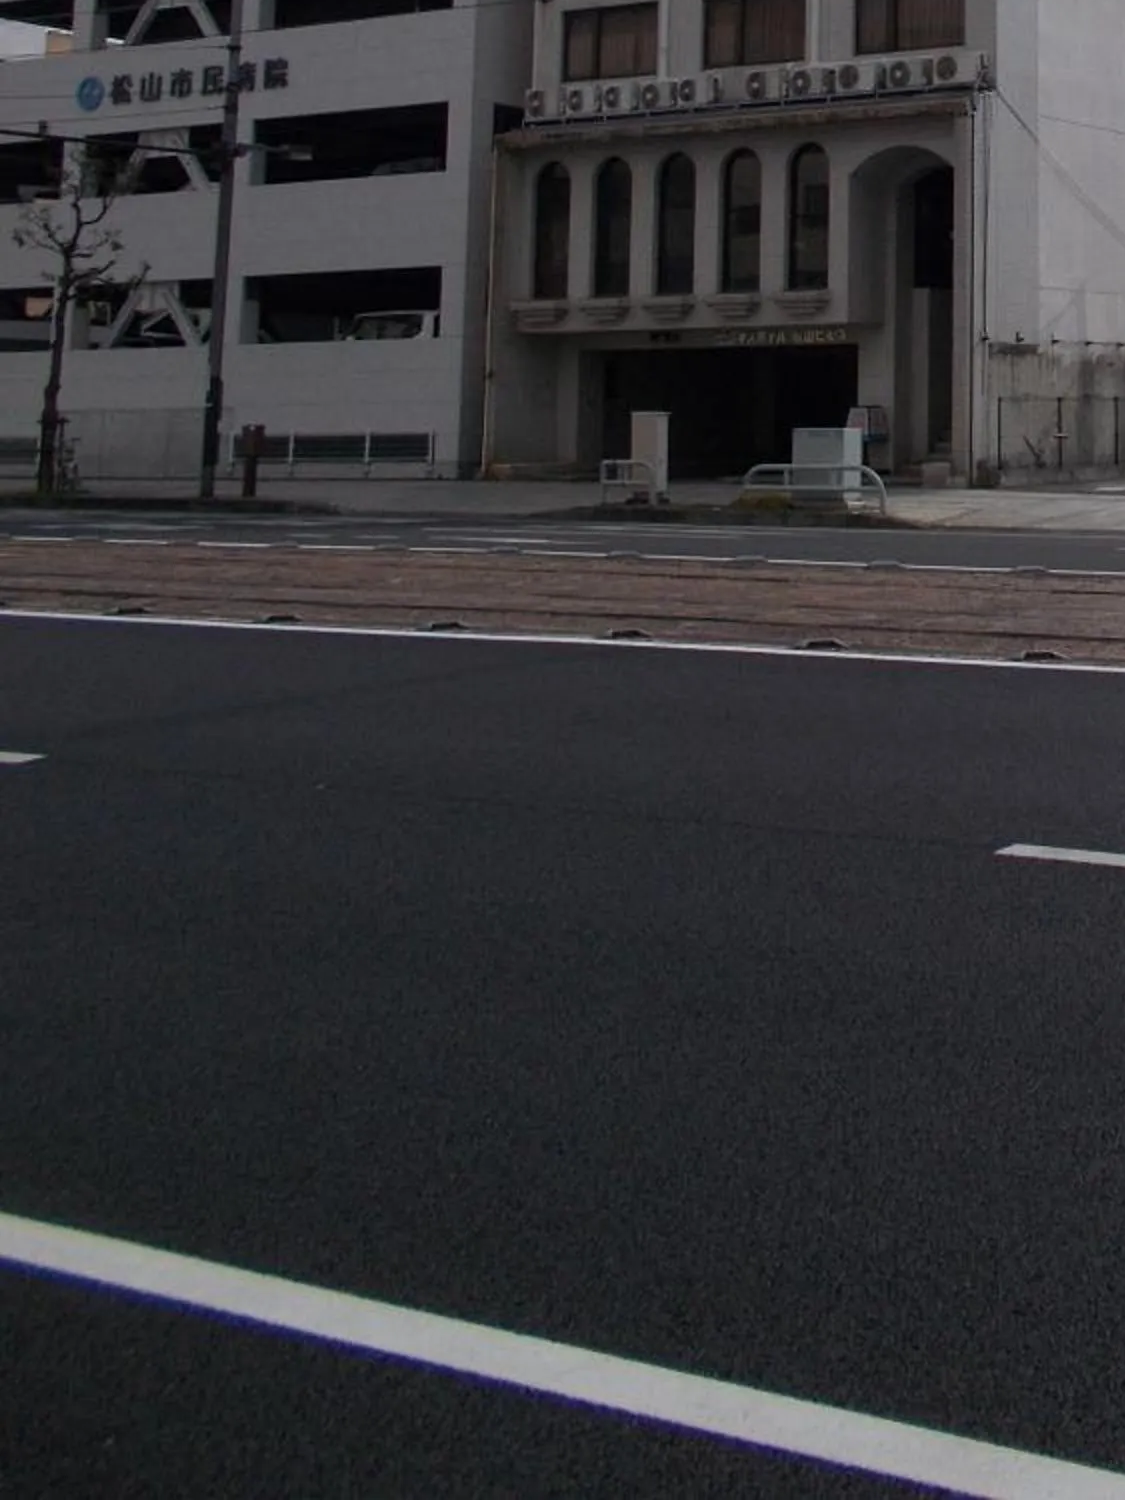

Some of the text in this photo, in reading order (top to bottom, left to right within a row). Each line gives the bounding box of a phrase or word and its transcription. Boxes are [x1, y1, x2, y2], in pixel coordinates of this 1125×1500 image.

[112, 58, 289, 105] 松山市民病院
